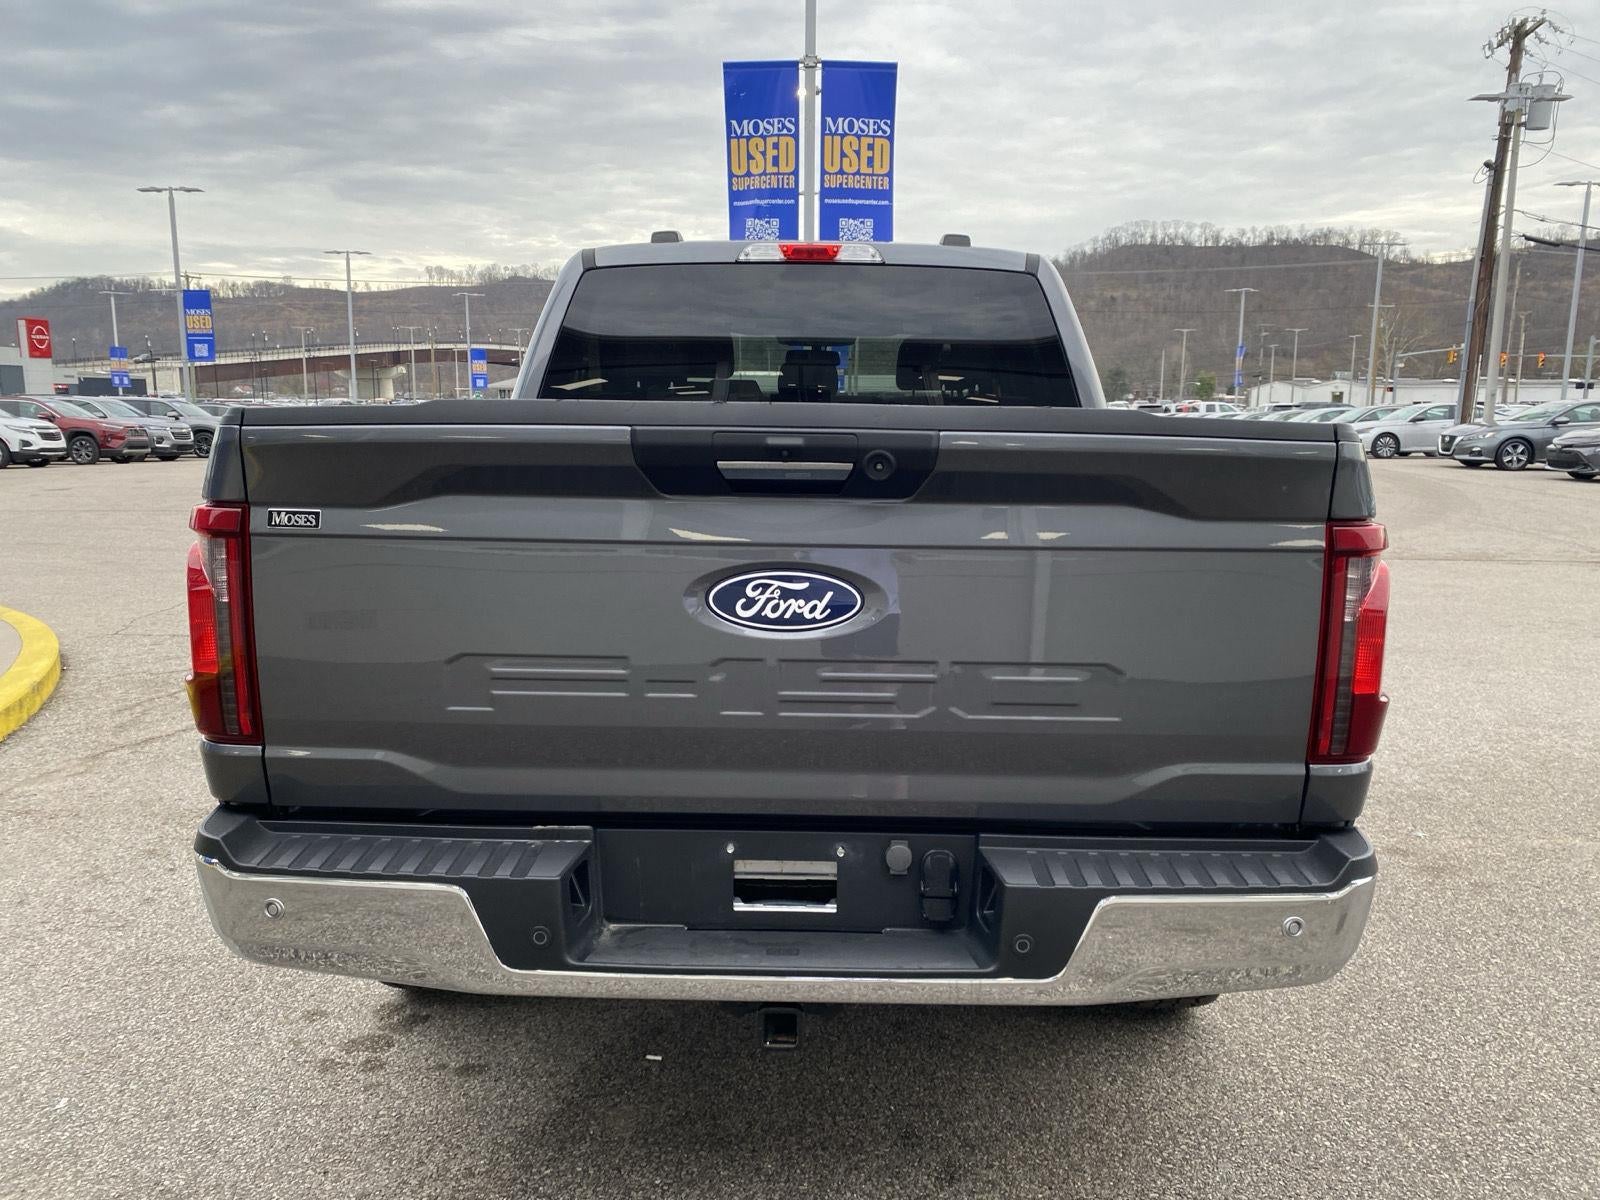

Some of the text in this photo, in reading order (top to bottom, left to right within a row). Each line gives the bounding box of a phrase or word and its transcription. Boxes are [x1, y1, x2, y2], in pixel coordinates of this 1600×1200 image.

[730, 117, 796, 137] MOSES
[825, 117, 891, 136] MOSES
[730, 137, 796, 175] USED
[824, 136, 890, 175] USED
[732, 175, 795, 191] SUPERCENTER
[824, 175, 889, 190] SUPERCENTER
[187, 316, 212, 329] USED
[271, 511, 316, 526] MOSES
[735, 579, 834, 620] Ford
